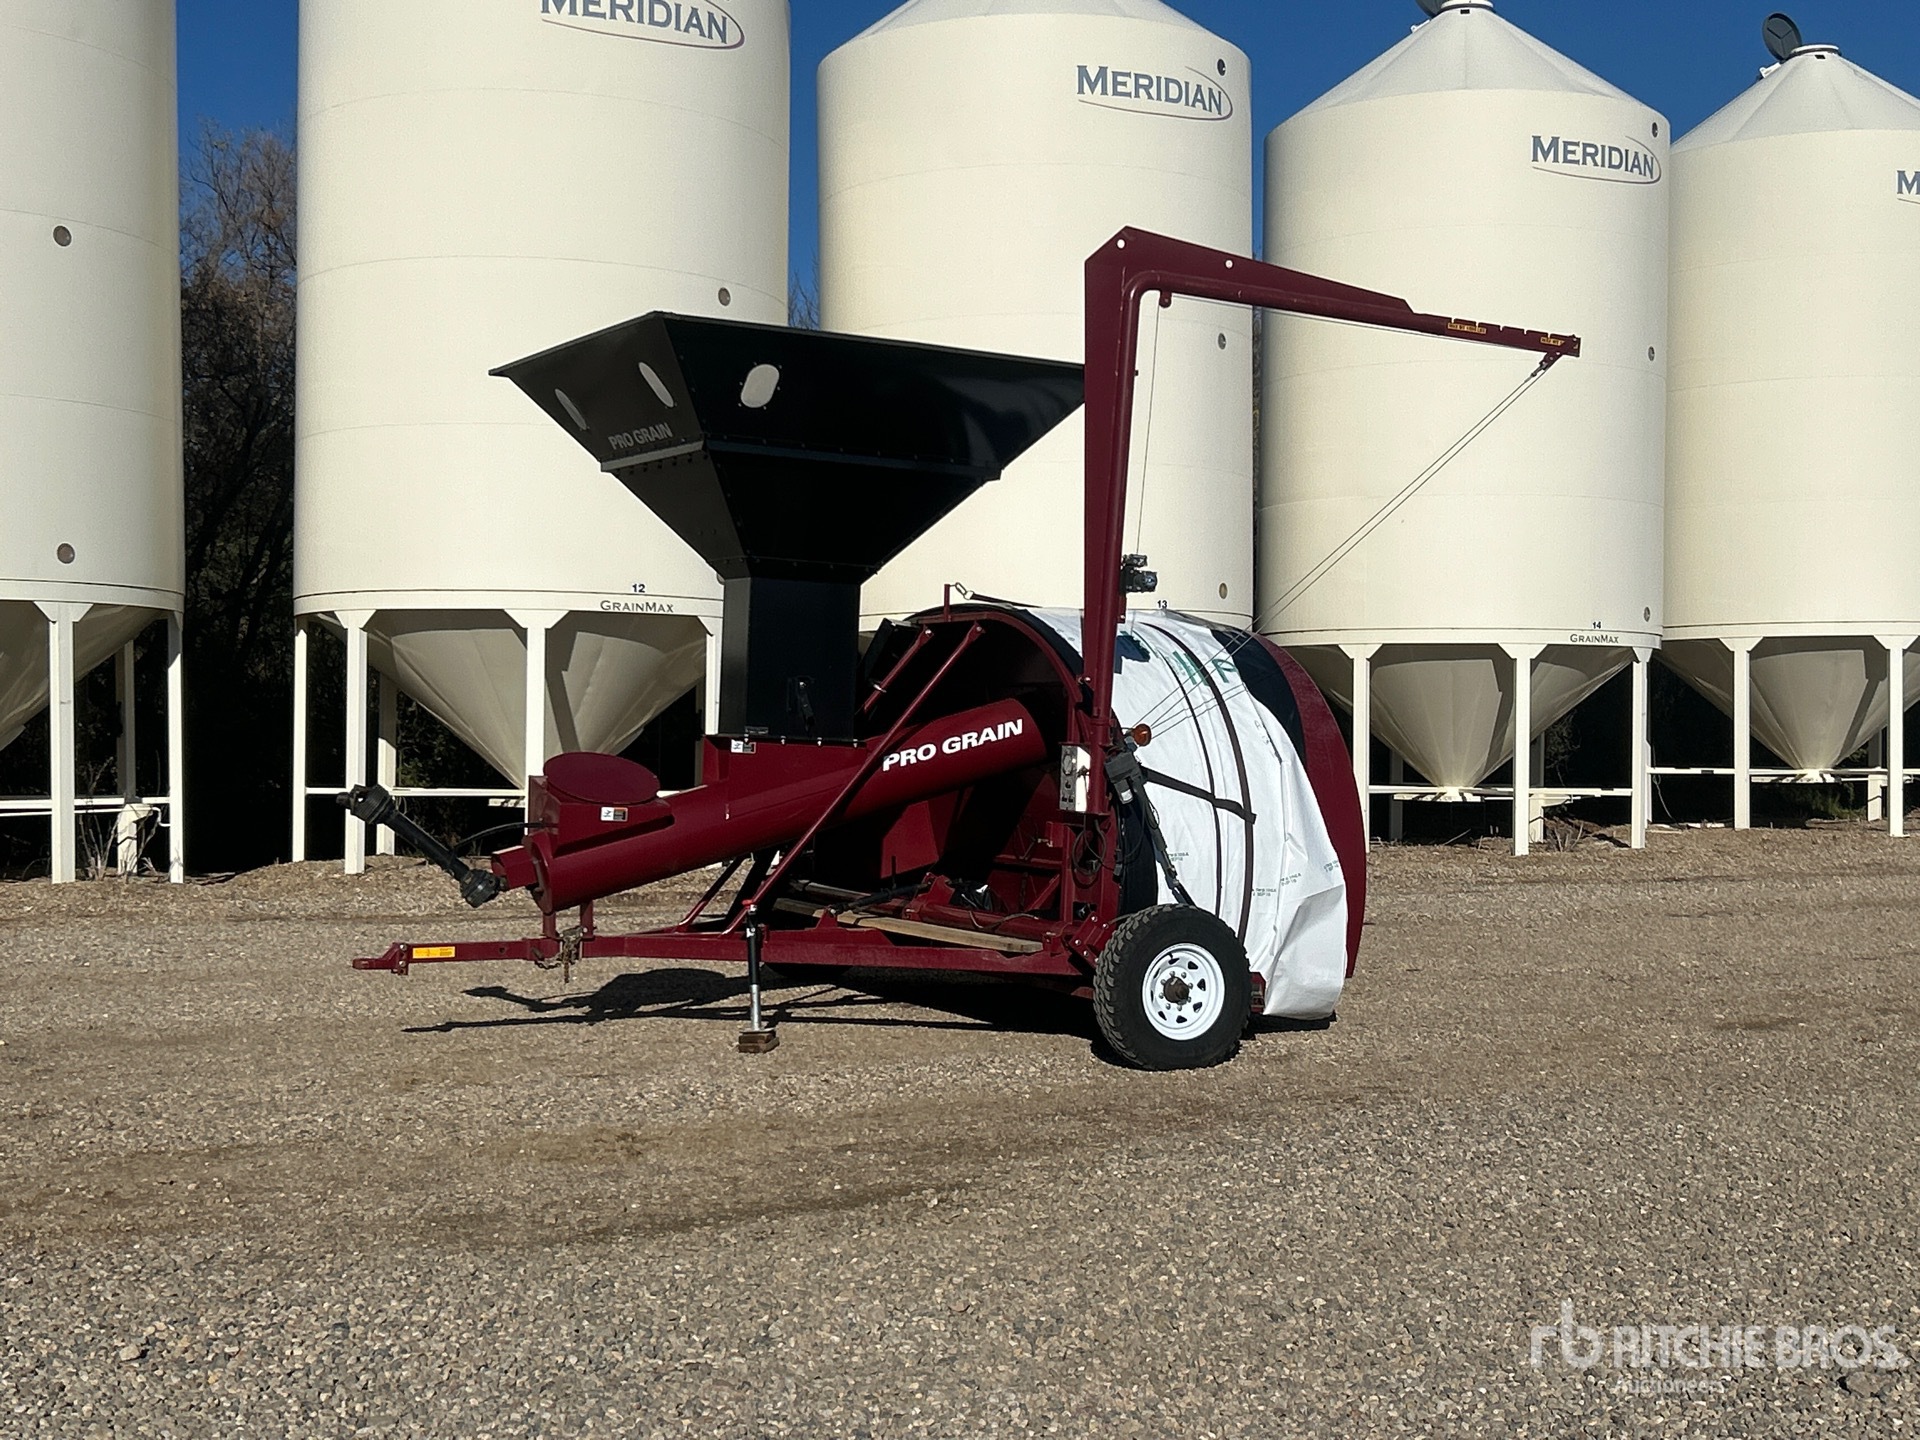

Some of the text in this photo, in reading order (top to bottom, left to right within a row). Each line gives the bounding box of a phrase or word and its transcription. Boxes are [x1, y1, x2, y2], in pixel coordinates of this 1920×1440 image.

[1077, 65, 1223, 116] MERIDIAN
[1531, 135, 1655, 179] MERIDIAN
[608, 422, 673, 450] PRO GRAIN
[632, 584, 646, 593] 12
[1157, 600, 1168, 609] 13
[1592, 621, 1602, 629] 14
[882, 719, 1023, 772] PRO GRAIN
